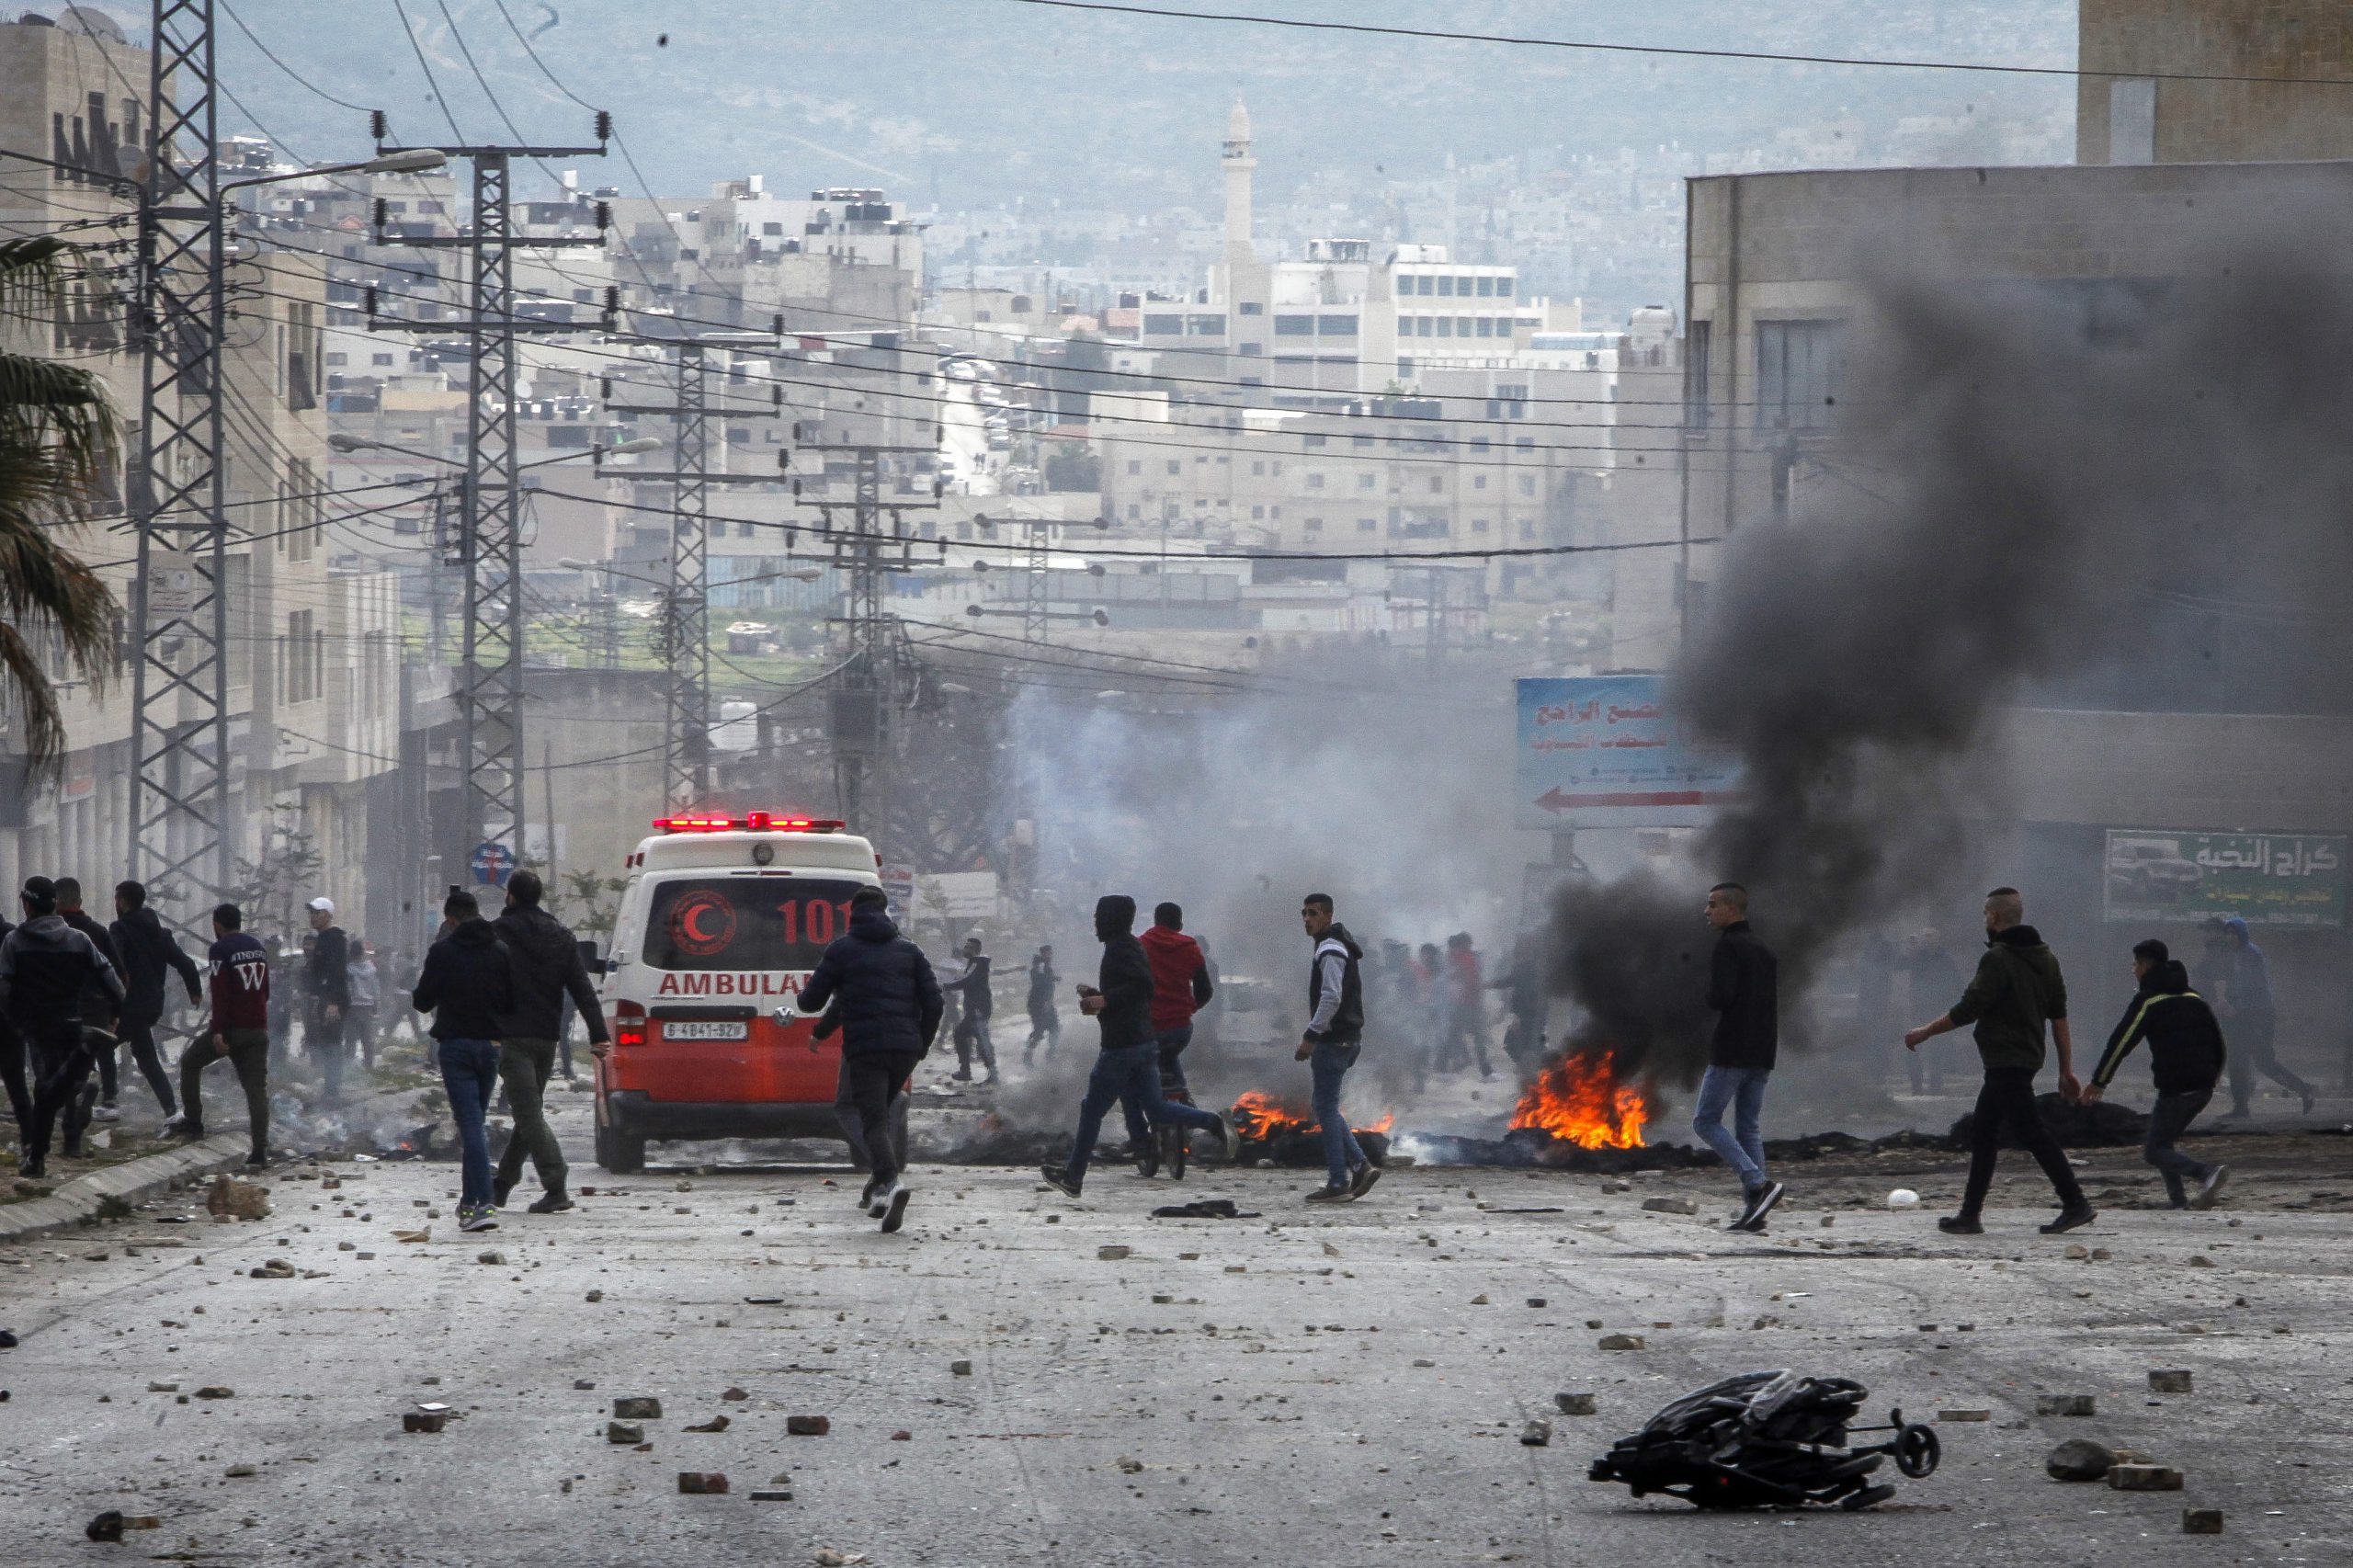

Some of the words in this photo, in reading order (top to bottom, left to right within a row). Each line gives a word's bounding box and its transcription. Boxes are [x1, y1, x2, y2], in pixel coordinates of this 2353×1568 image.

[2196, 836, 2271, 875] النخبة
[2275, 840, 2339, 876] كراج
[776, 898, 853, 944] 101
[233, 962, 266, 990] W
